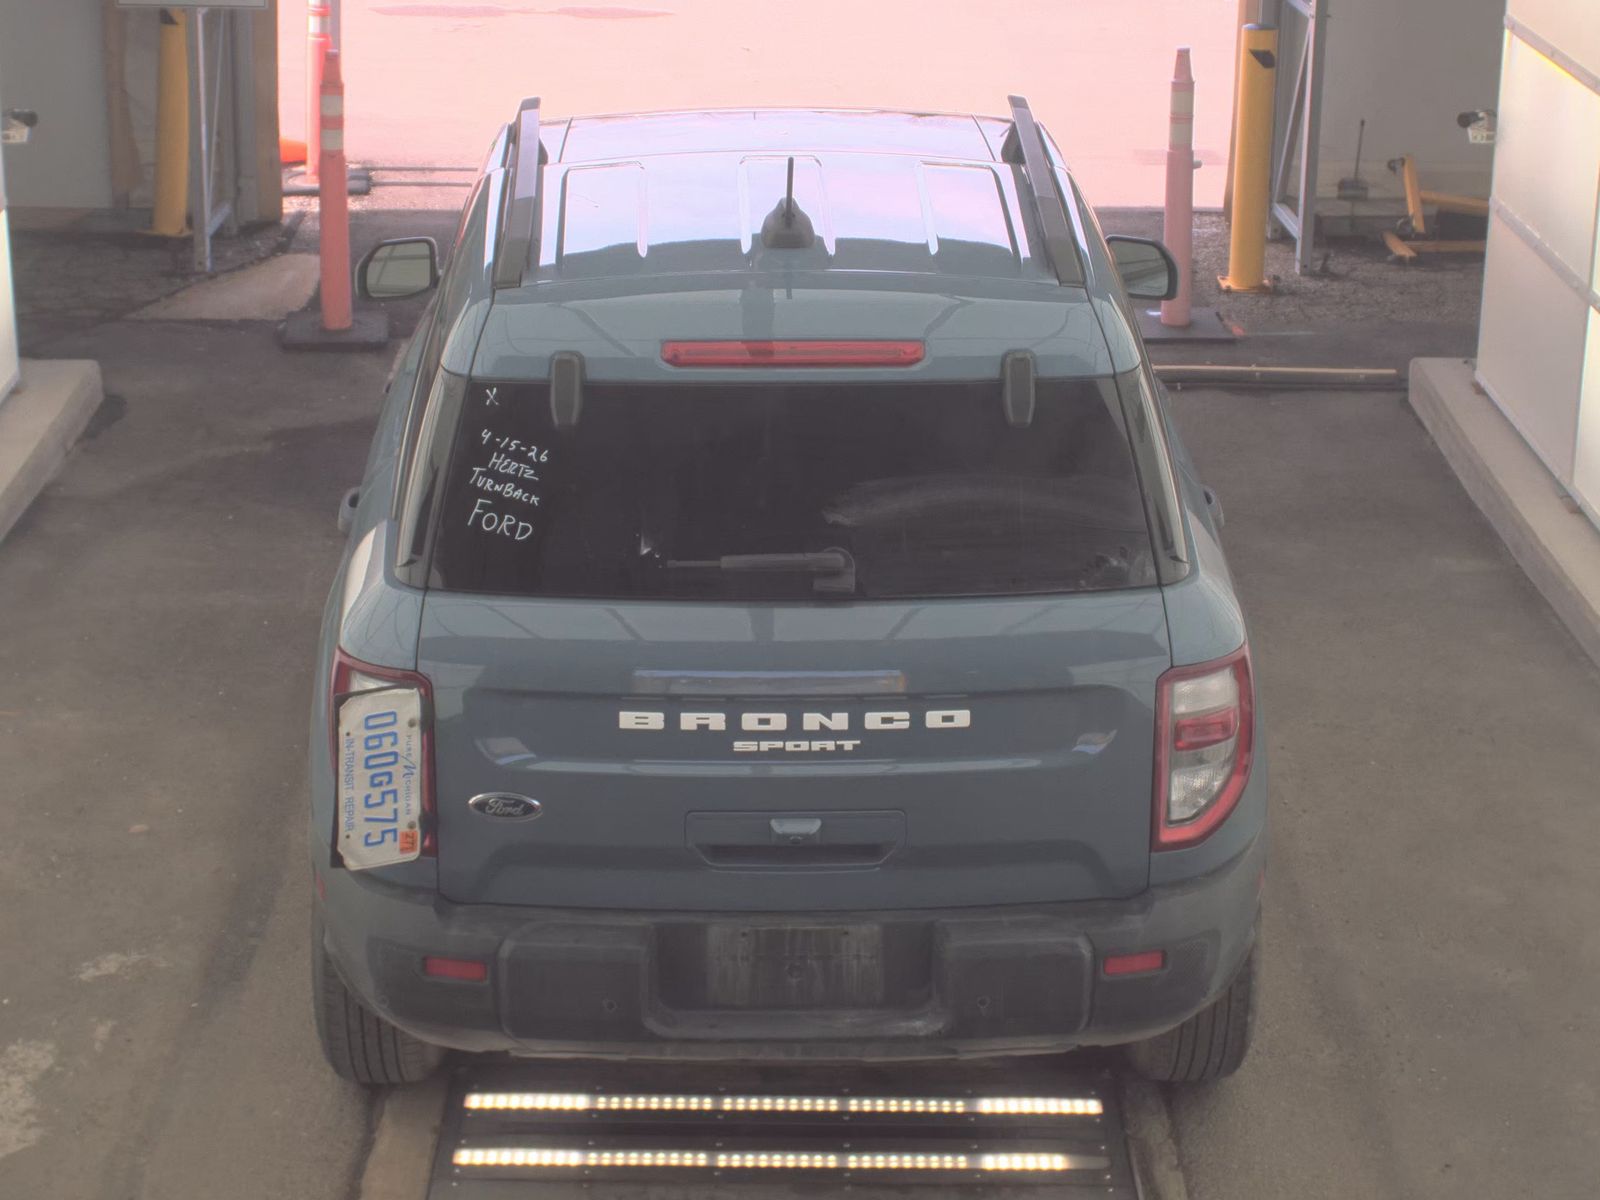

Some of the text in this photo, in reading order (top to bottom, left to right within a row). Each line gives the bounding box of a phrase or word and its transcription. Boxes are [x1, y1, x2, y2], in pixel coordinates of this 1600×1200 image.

[481, 429, 549, 462] 4-15-26
[488, 452, 539, 480] HERTZ
[468, 499, 533, 540] FORD
[619, 710, 971, 731] BRONCO
[733, 740, 861, 751] SPORT
[345, 738, 355, 832] IN-TRANSIT REPAIR
[364, 711, 398, 847] 060G575
[485, 798, 524, 817] Ford
